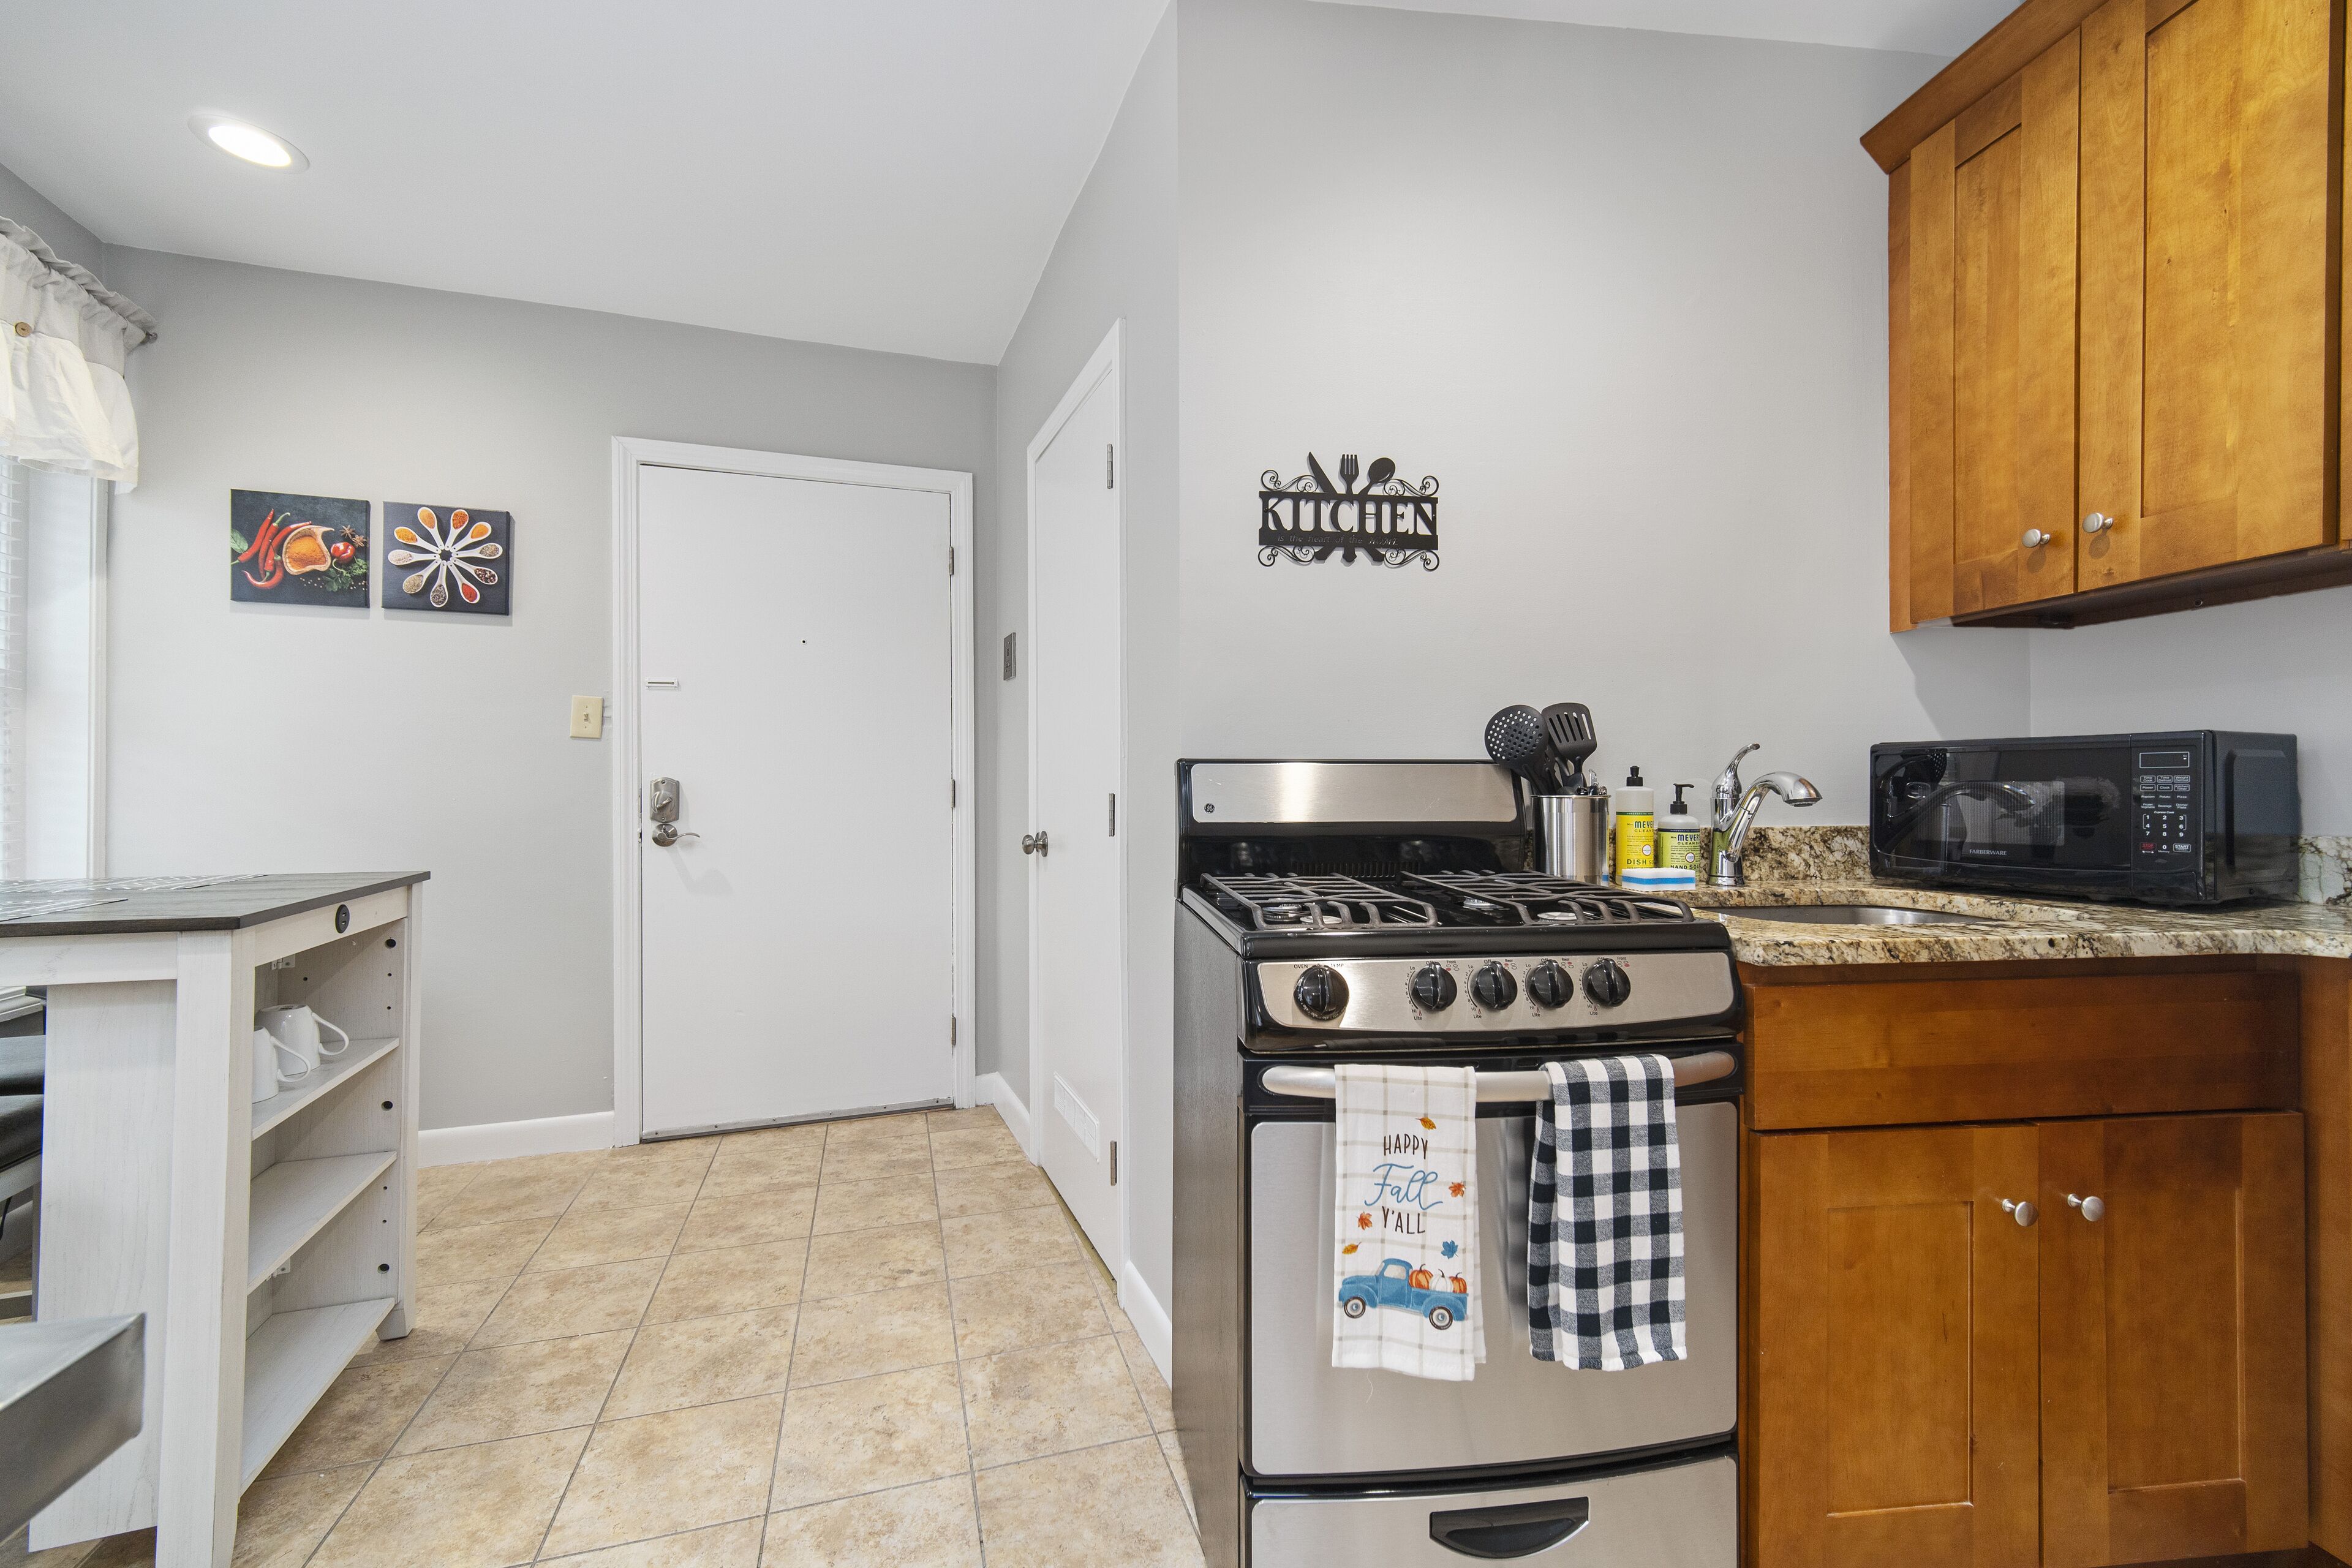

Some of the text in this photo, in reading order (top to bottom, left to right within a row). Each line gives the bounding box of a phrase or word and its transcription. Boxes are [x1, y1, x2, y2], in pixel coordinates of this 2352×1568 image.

[1259, 492, 1438, 536] KITCHEN
[1308, 535, 1330, 543] heart
[1335, 535, 1344, 543] of
[1349, 535, 1363, 544] the
[1383, 1133, 1428, 1159] HAPPY
[1364, 1163, 1443, 1210] Fall
[1382, 1205, 1426, 1234] Y'ALL
